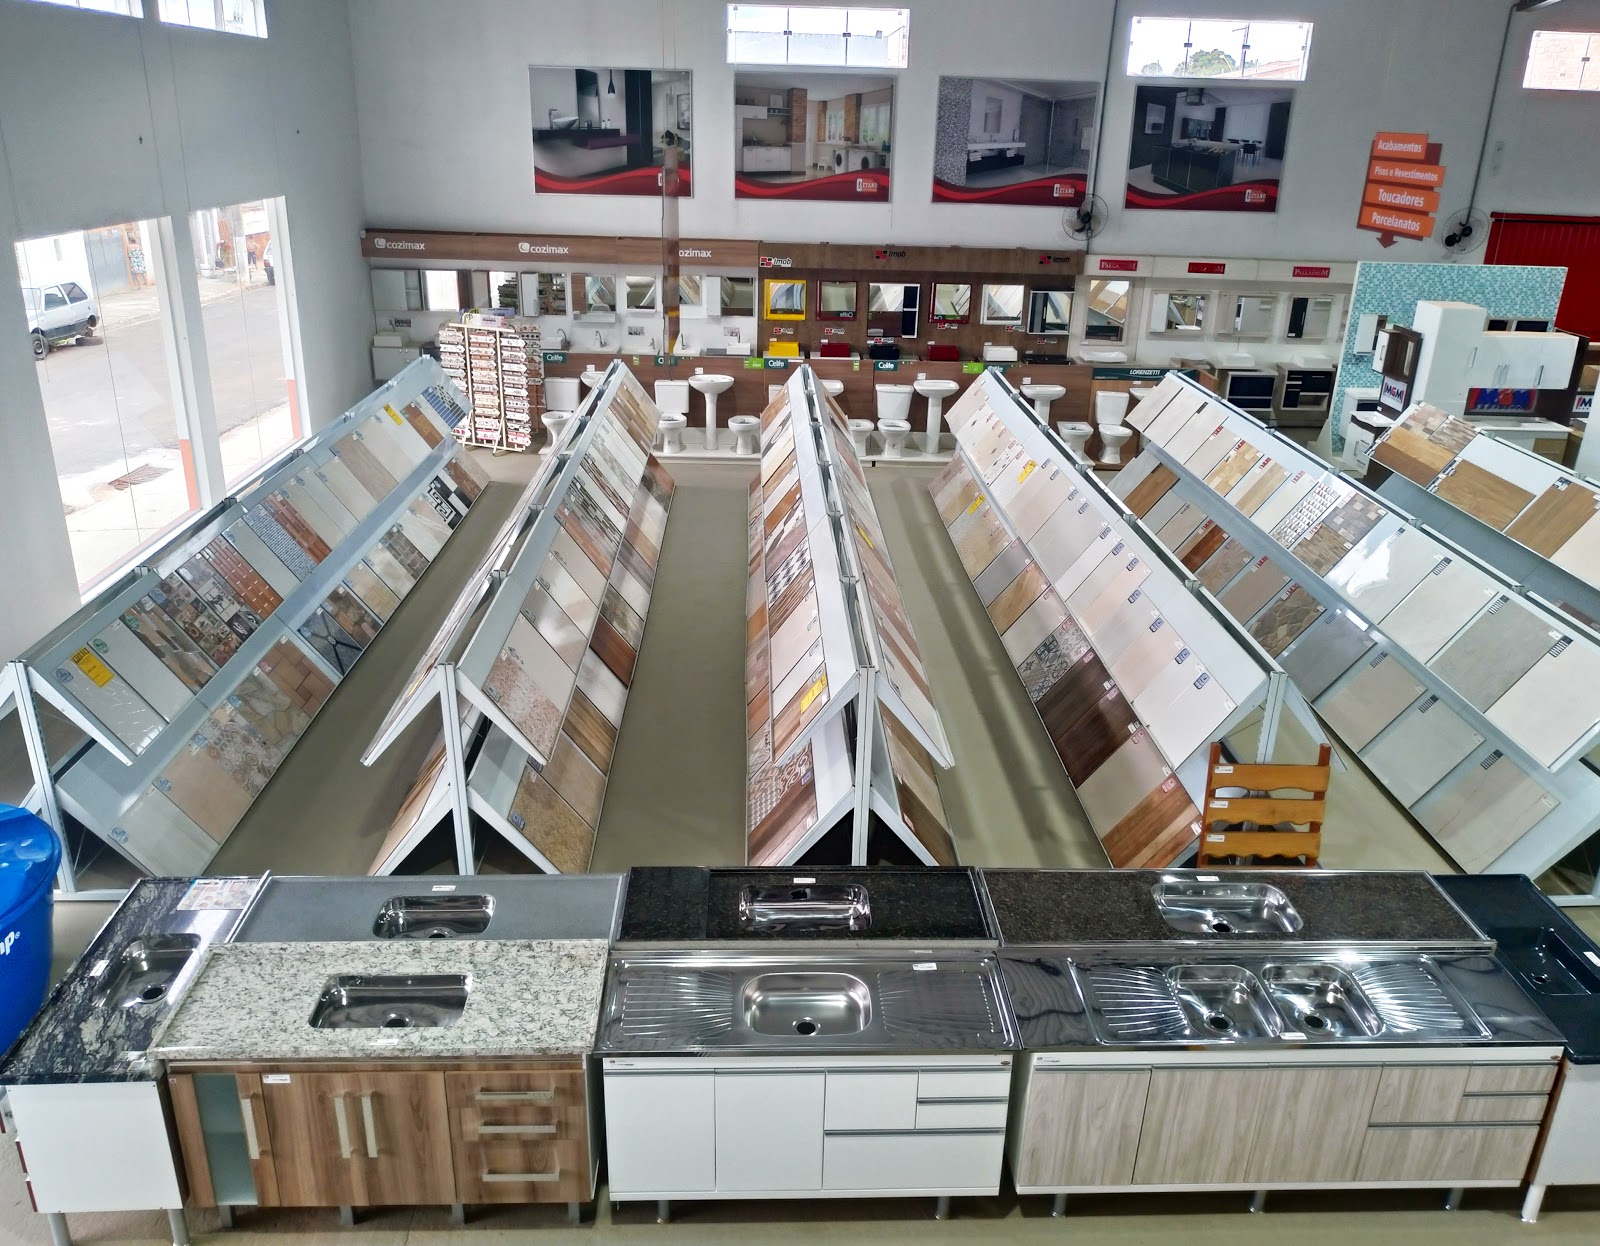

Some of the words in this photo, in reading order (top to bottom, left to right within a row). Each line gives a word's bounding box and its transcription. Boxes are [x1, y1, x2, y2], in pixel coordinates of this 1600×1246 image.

[1378, 140, 1422, 153] Acabamentos
[1374, 166, 1389, 176] Pisos
[1394, 168, 1438, 182] Revestimentos
[1378, 189, 1424, 207] Toucadores
[1372, 212, 1420, 231] Porcelanatos
[386, 241, 425, 250] cozimax
[530, 244, 569, 255] cozimax
[678, 248, 712, 258] ozimax
